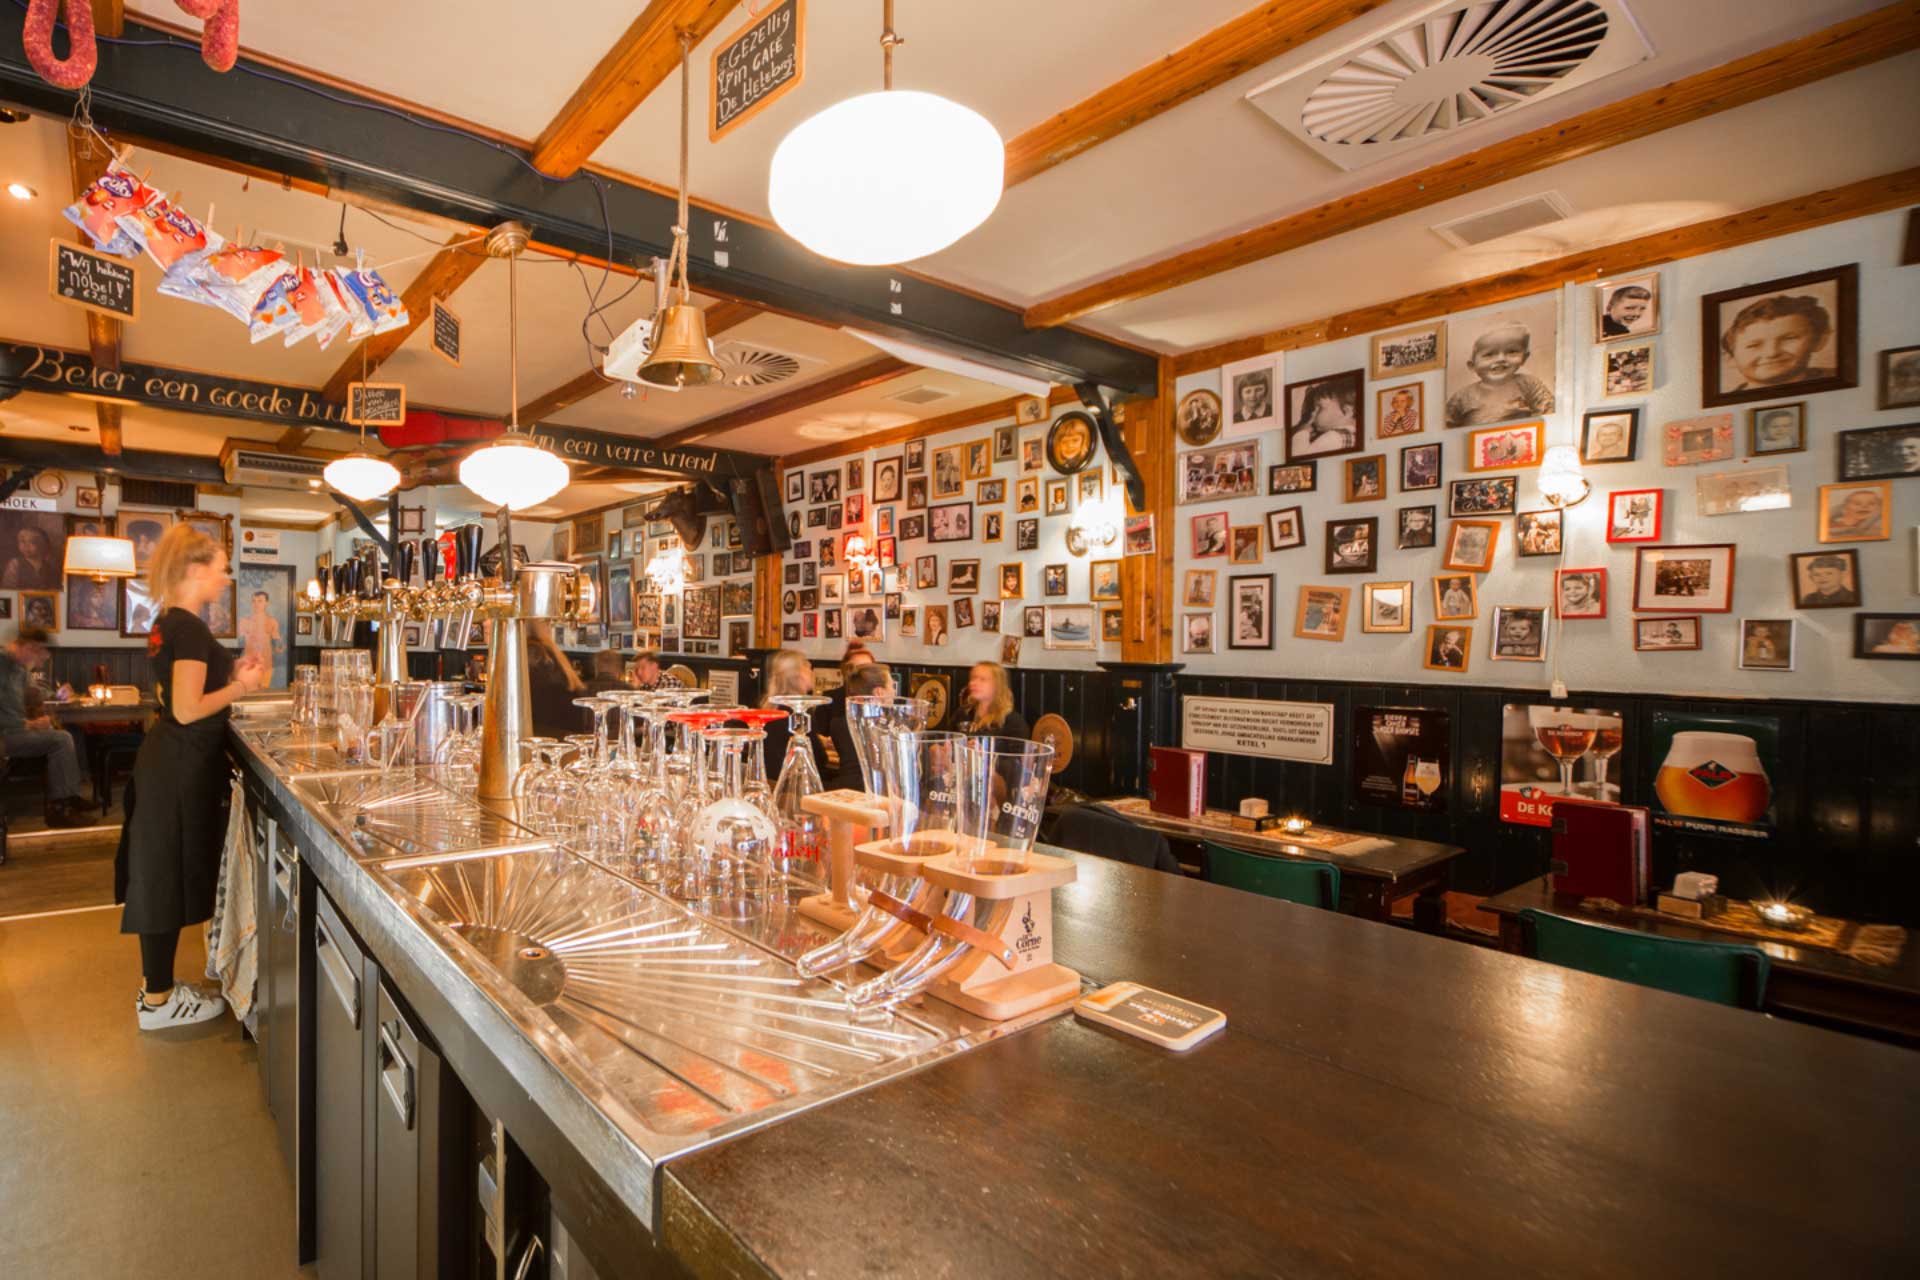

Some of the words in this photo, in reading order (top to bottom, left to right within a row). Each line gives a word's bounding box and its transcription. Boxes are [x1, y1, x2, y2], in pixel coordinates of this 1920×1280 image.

[145, 377, 199, 403] een
[564, 438, 598, 457] een
[606, 444, 655, 464] verre
[662, 452, 718, 472] vriend
[1236, 740, 1260, 748] KETEL
[1517, 801, 1535, 814] DE
